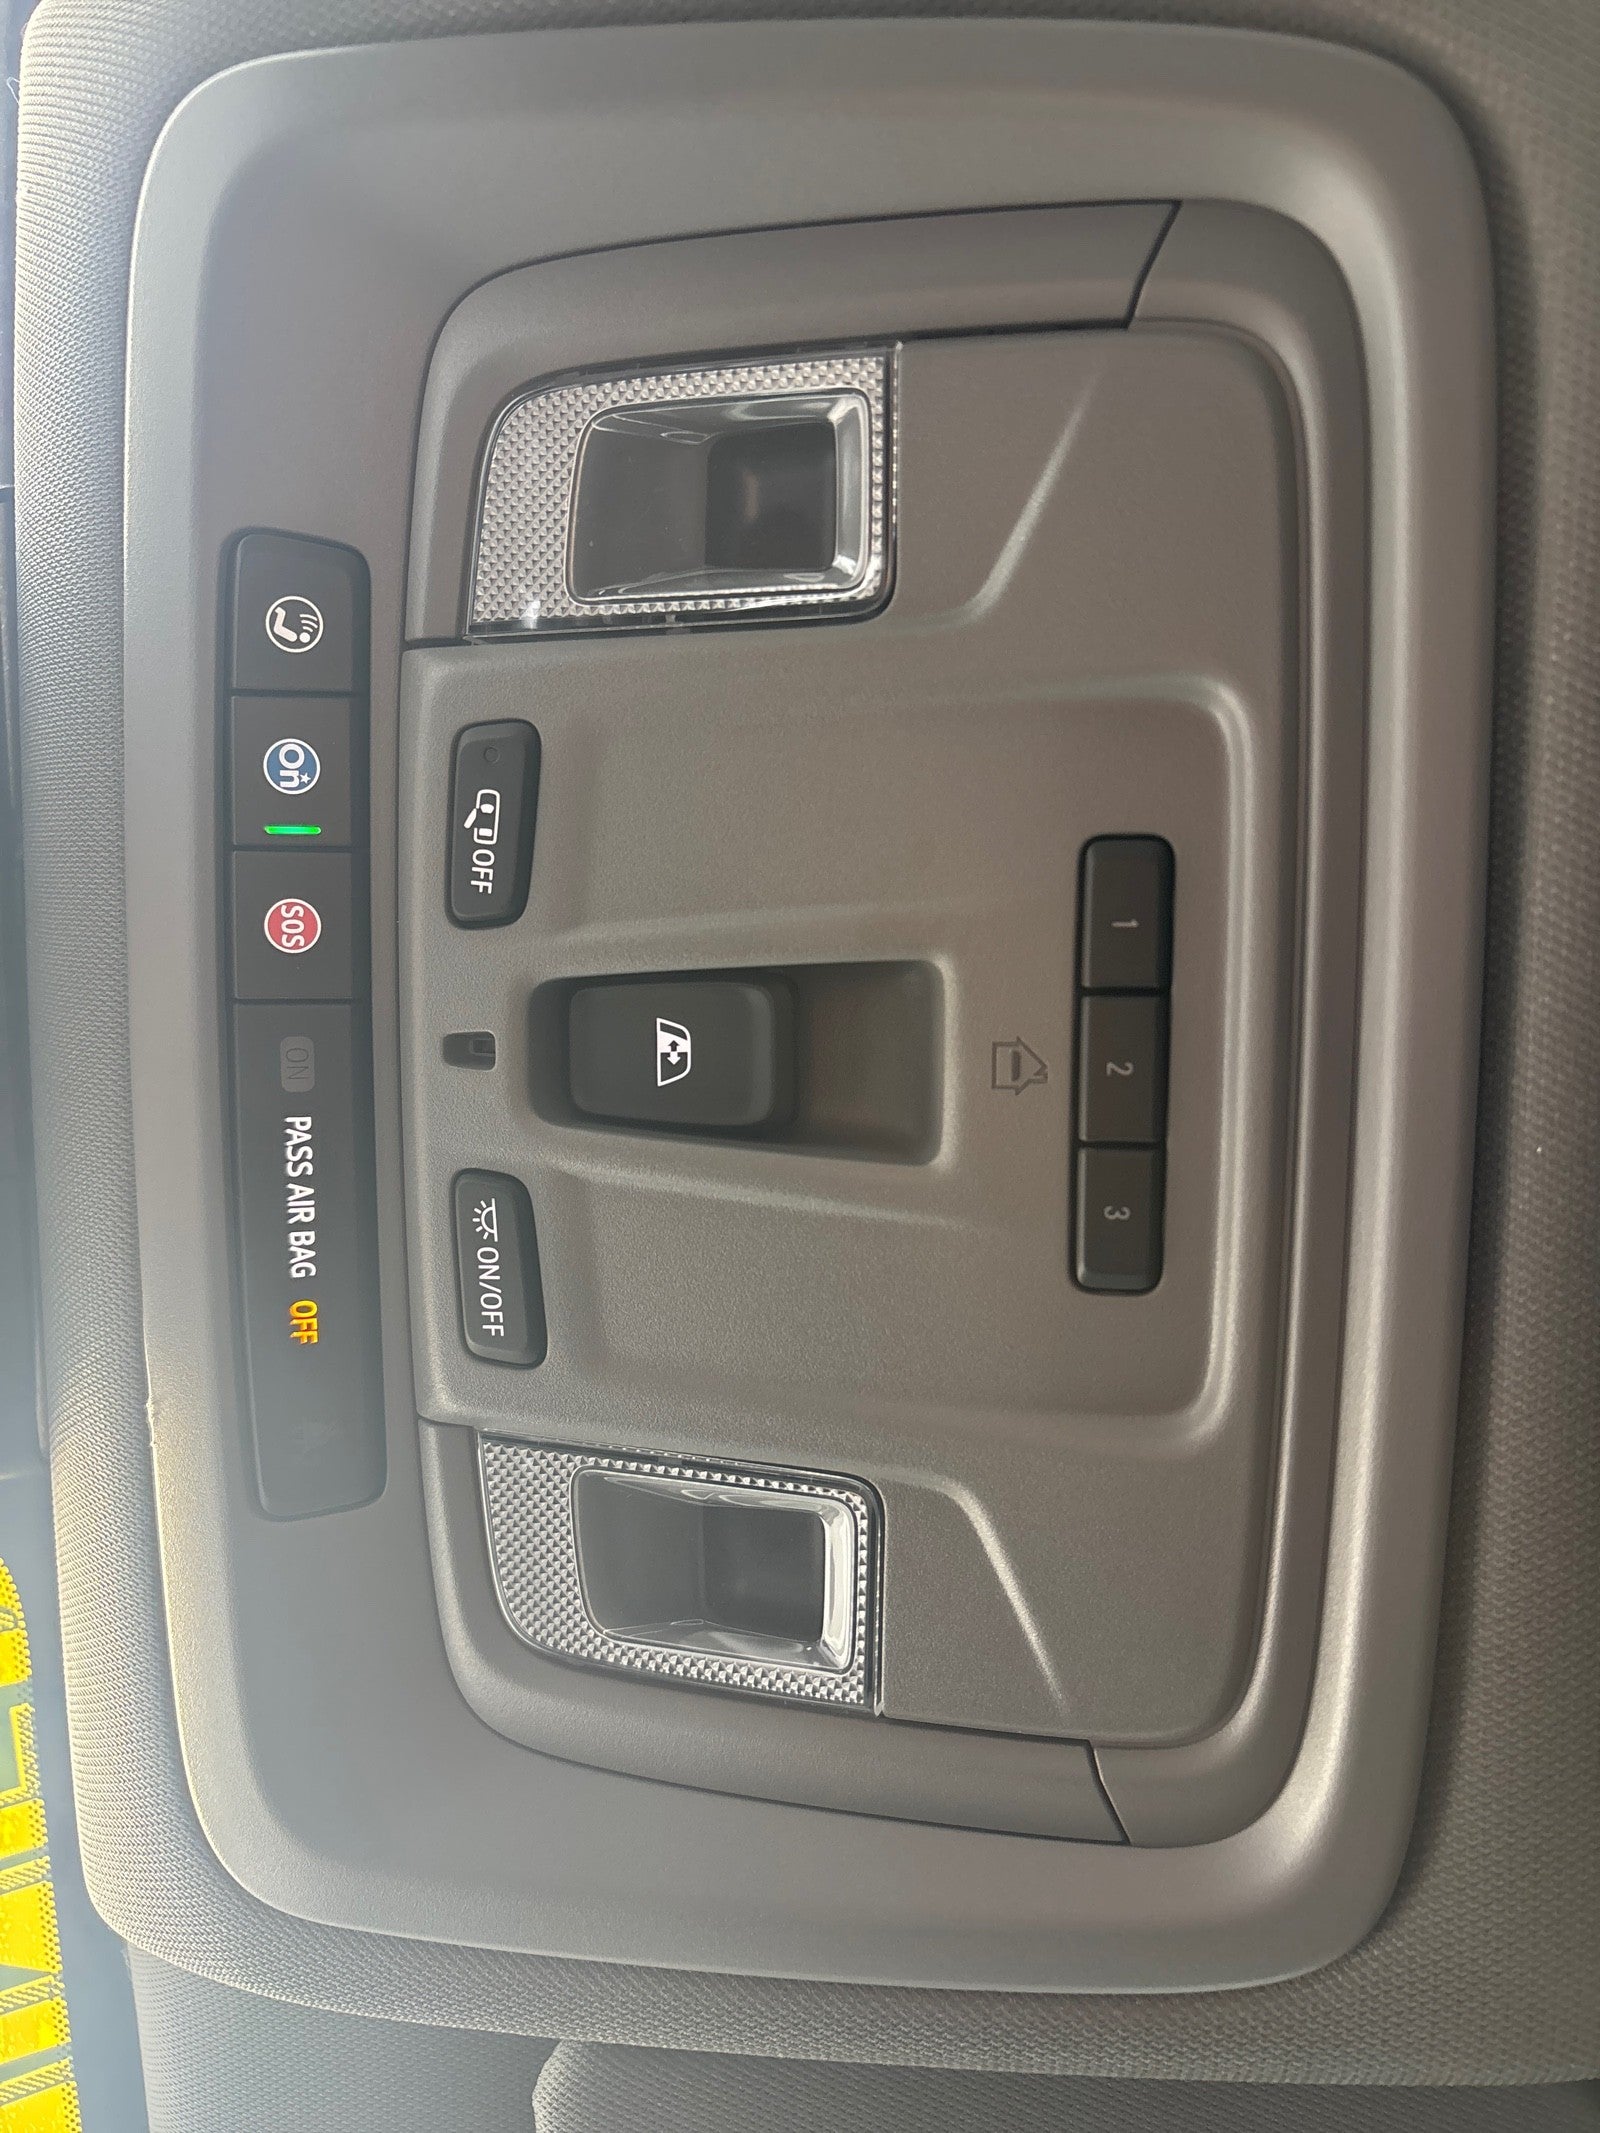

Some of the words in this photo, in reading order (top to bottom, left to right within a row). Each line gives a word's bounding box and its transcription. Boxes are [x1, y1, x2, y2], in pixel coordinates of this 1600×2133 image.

[470, 848, 495, 895] OFF
[281, 904, 306, 949] SOS
[1110, 918, 1140, 930] 1
[285, 1046, 311, 1082] ON
[1105, 1061, 1134, 1077] 2
[284, 1116, 314, 1178] PASS
[286, 1183, 316, 1225] AIR
[1103, 1205, 1131, 1222] 3
[288, 1231, 318, 1279] BAG
[476, 1246, 505, 1337] ON/OFF
[288, 1299, 319, 1345] OFF
